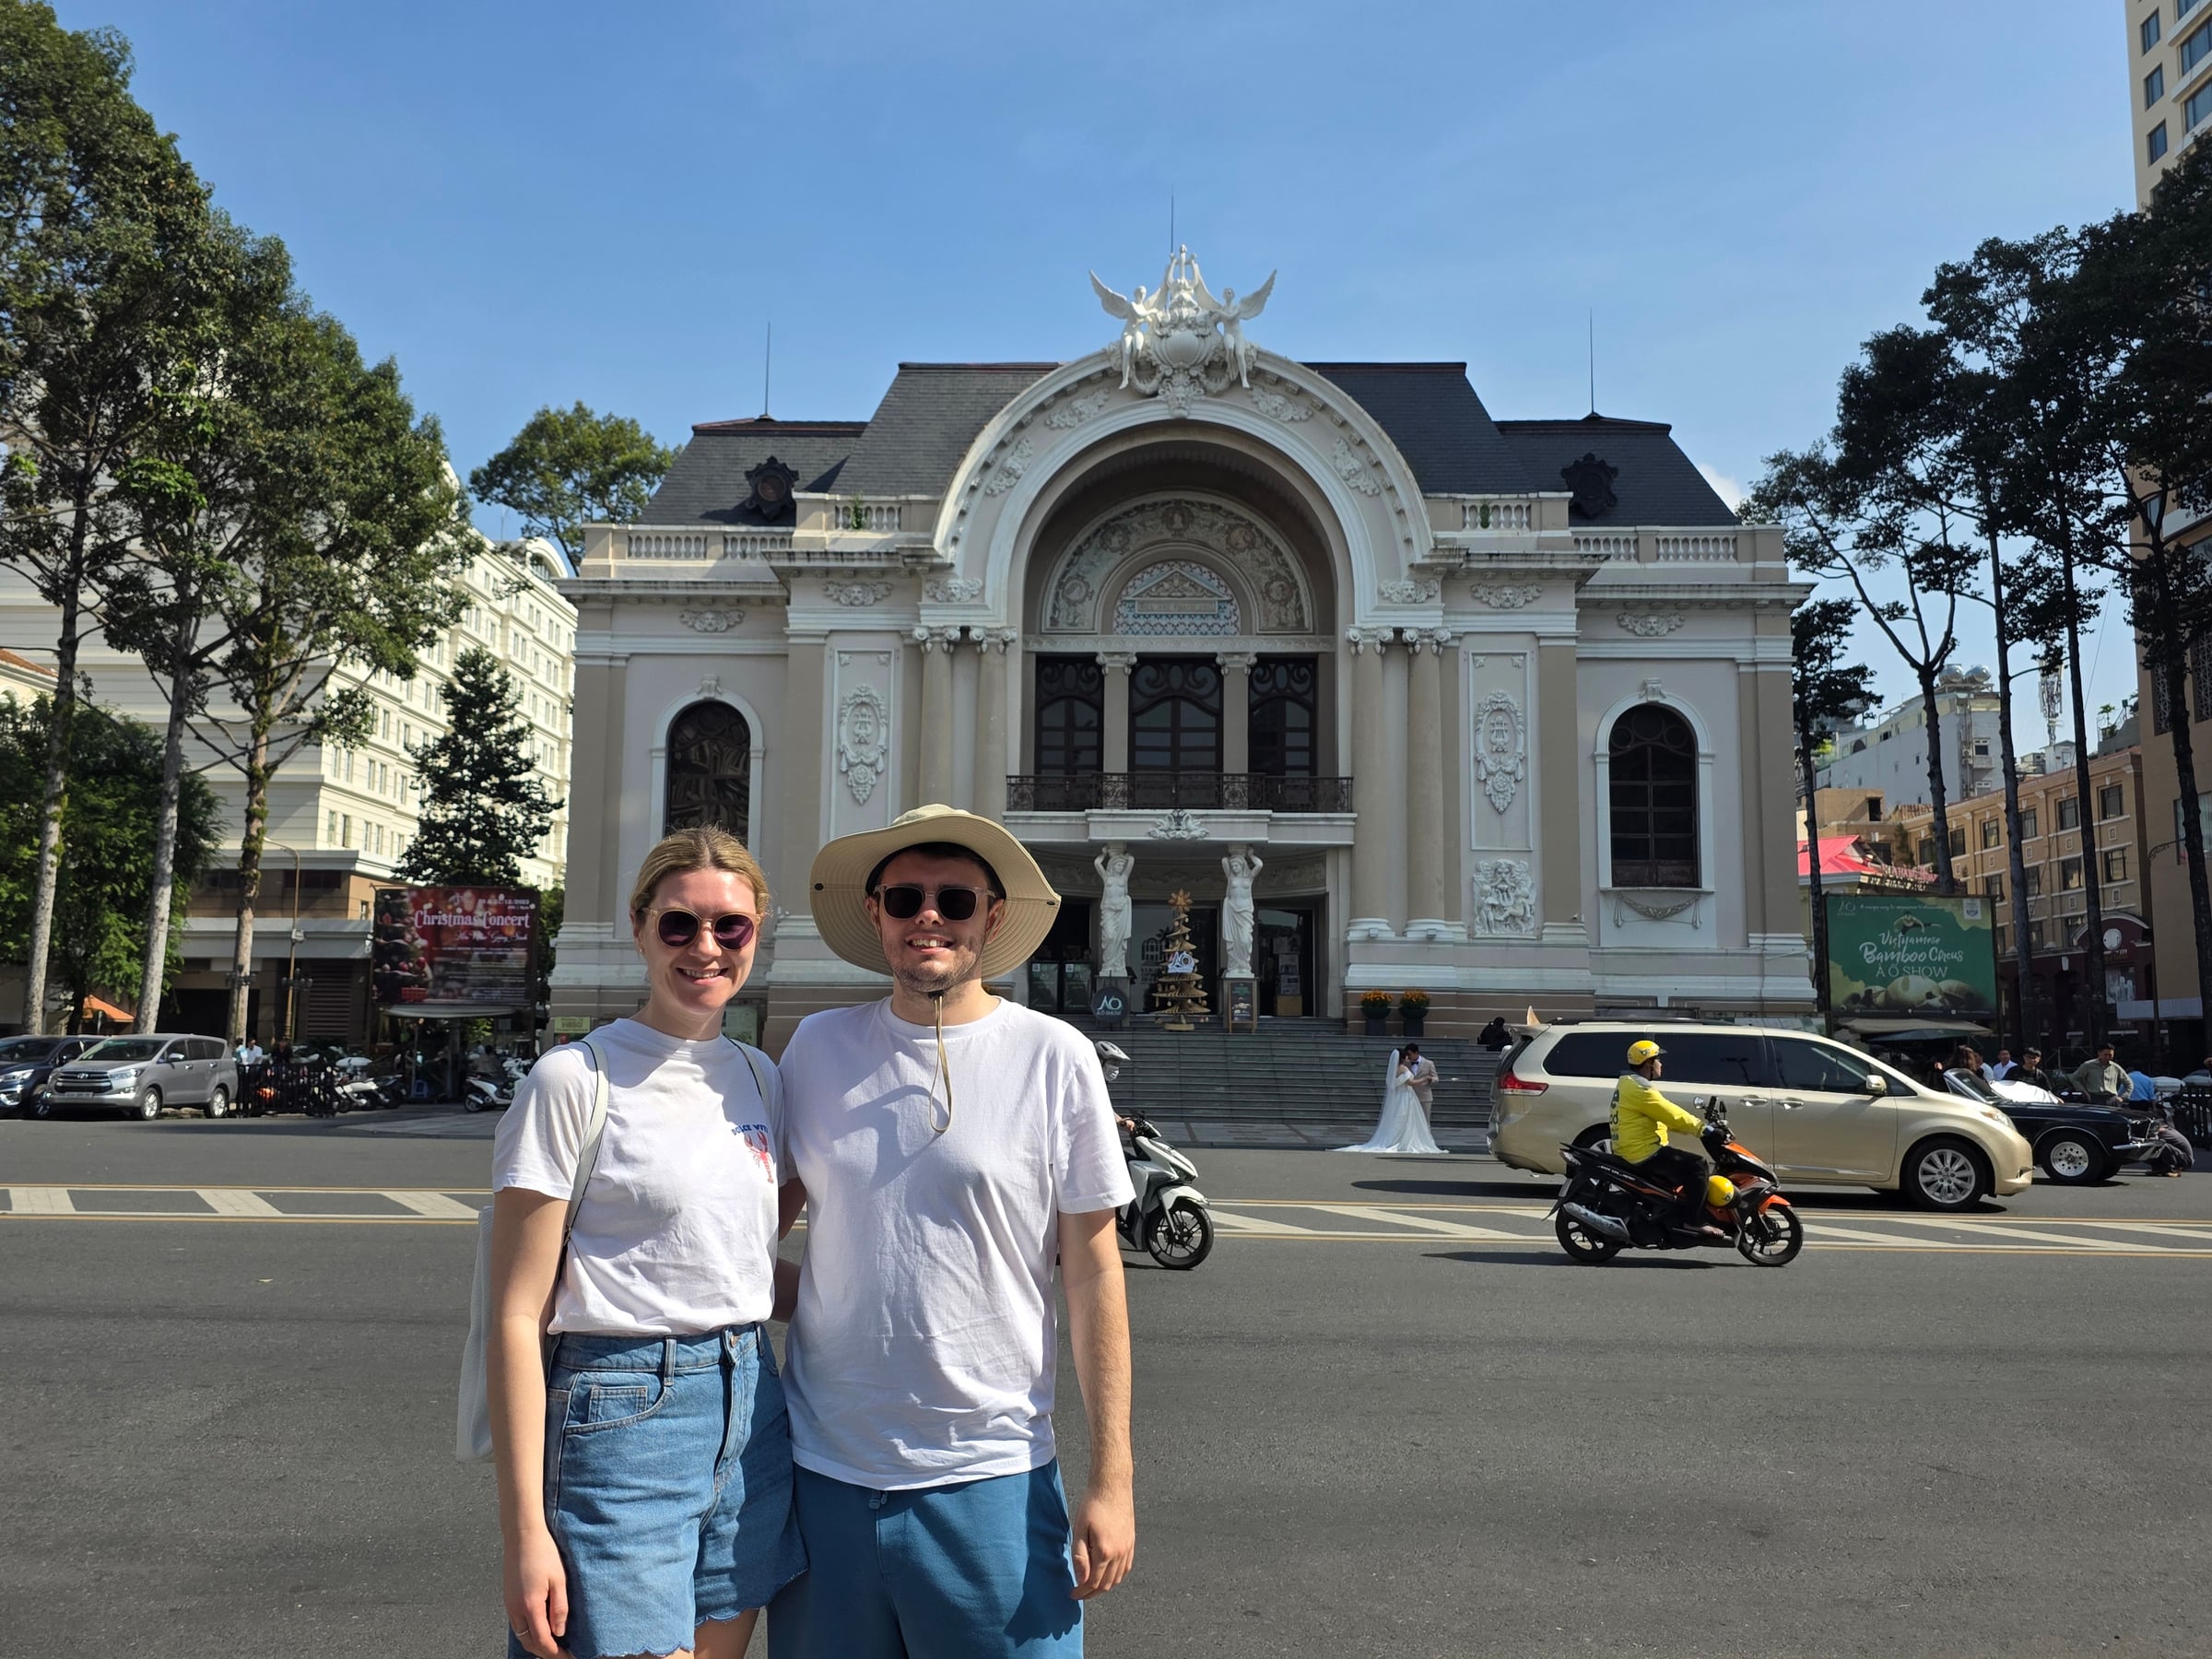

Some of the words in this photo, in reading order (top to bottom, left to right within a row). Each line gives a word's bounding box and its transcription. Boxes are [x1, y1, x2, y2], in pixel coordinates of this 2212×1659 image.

[414, 910, 478, 929] Christmas
[482, 911, 531, 929] Concert
[1878, 929, 1941, 948] Vietnamese
[1859, 941, 1927, 965] Bamboo
[1928, 947, 1964, 962] Circus
[1902, 966, 1948, 978] SHOW
[732, 1125, 752, 1135] DOLCE
